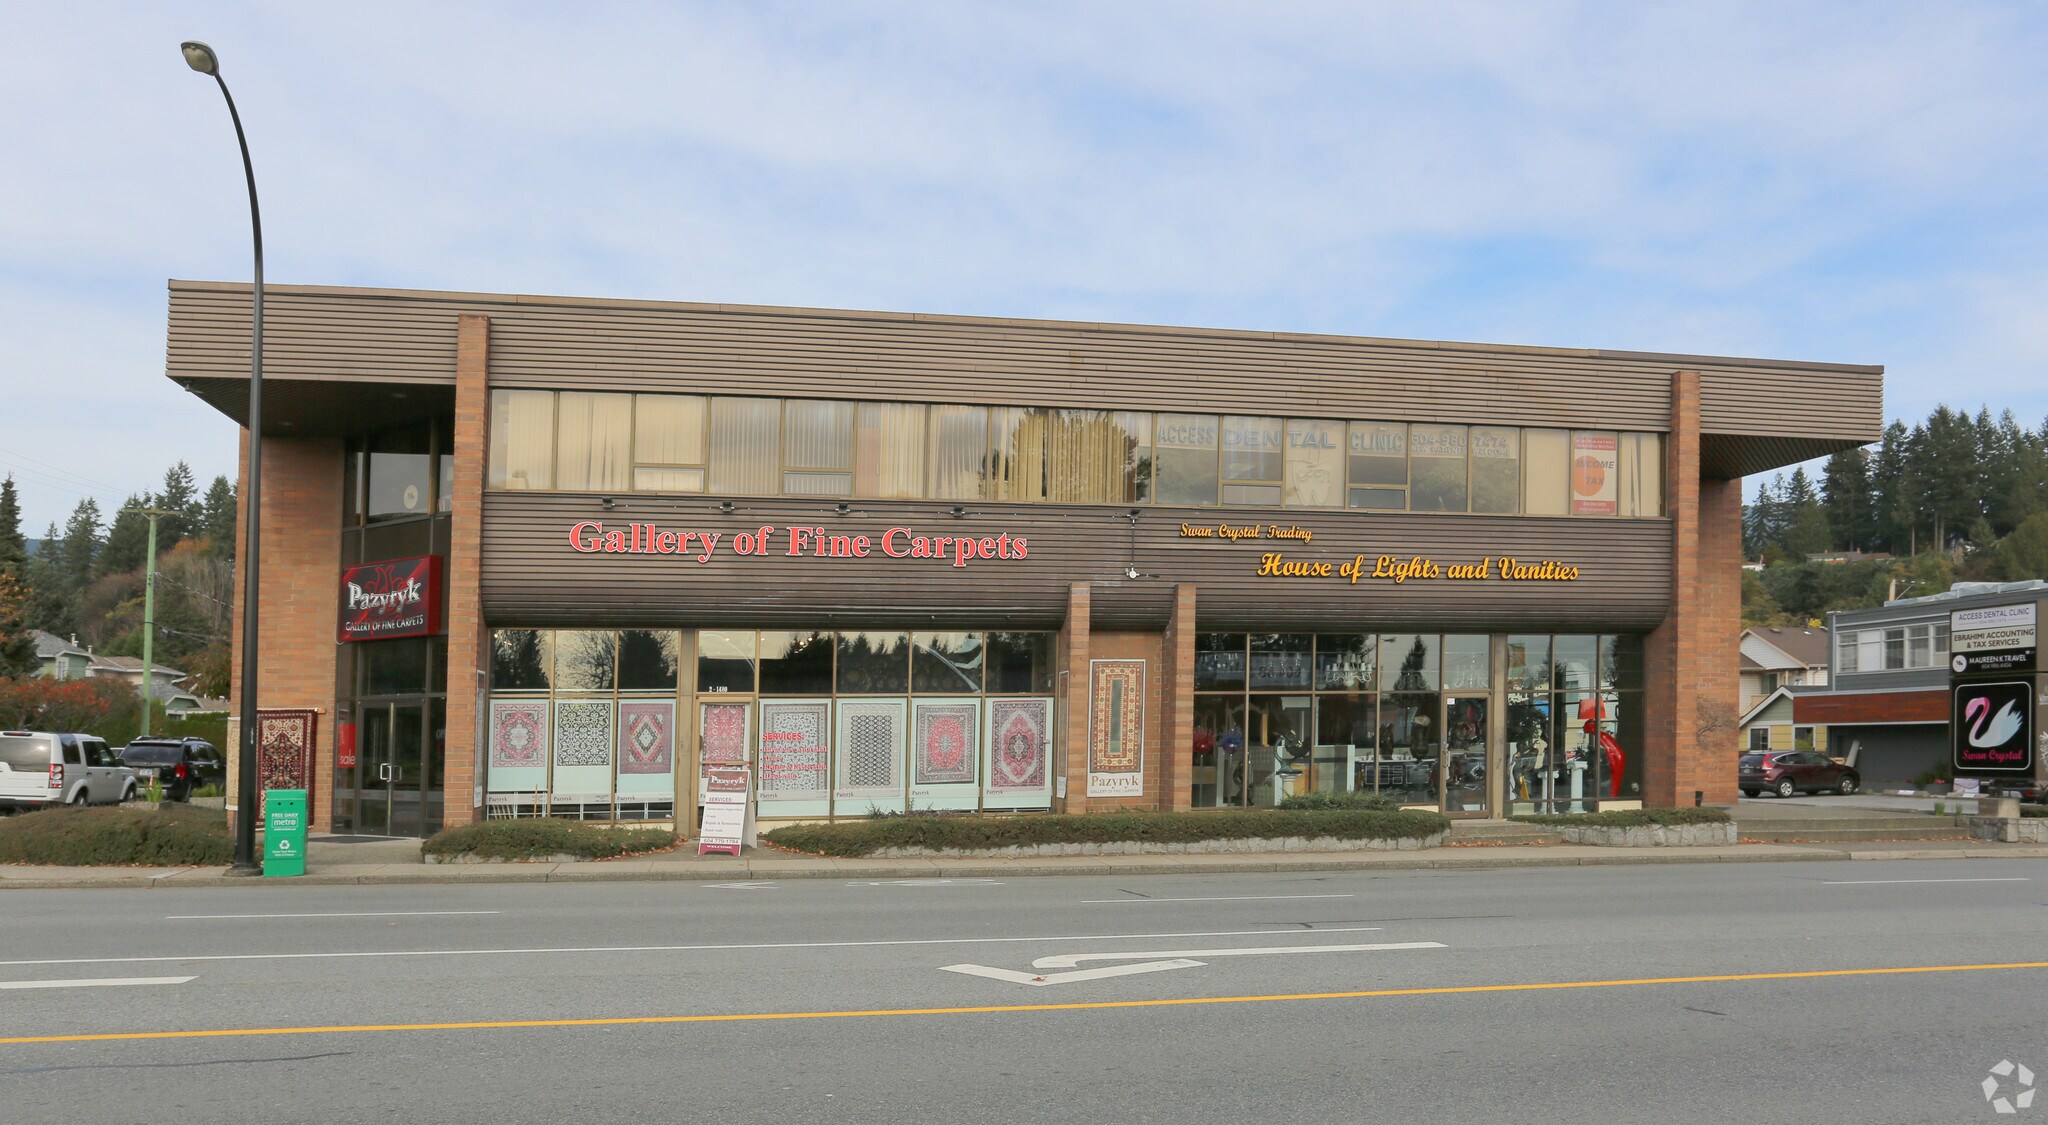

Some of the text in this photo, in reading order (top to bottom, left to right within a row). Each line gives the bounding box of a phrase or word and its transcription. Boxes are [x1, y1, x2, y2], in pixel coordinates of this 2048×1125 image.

[1157, 425, 1215, 444] ACCESS
[1223, 428, 1337, 449] DENTAL
[1351, 431, 1404, 450] CLINIC
[1411, 433, 1467, 446] 604-980
[1576, 460, 1615, 469] INCOME
[1585, 476, 1606, 485] TAX
[1179, 522, 1313, 544] Swan Crystal Trading
[569, 521, 1028, 567] Gallery of Fine Carpets
[1257, 552, 1580, 584] House of Lights and Vanities
[347, 577, 422, 615] Pazyryk
[1959, 608, 2029, 620] ACCESS DENTAL CLINIC
[345, 614, 424, 631] GALLERY OF FINE CARPETS
[1954, 629, 2034, 642] EBRAHIMI ACCOUNTING
[1988, 638, 2020, 647] SERVICES
[1969, 656, 1999, 664] MAUREEN
[2004, 654, 2027, 662] TRAVEL
[340, 748, 356, 765] sale
[1962, 749, 2023, 762] Swan Crystal
[711, 775, 745, 786] Pazyryk
[1091, 775, 1139, 789] Pazyryk
